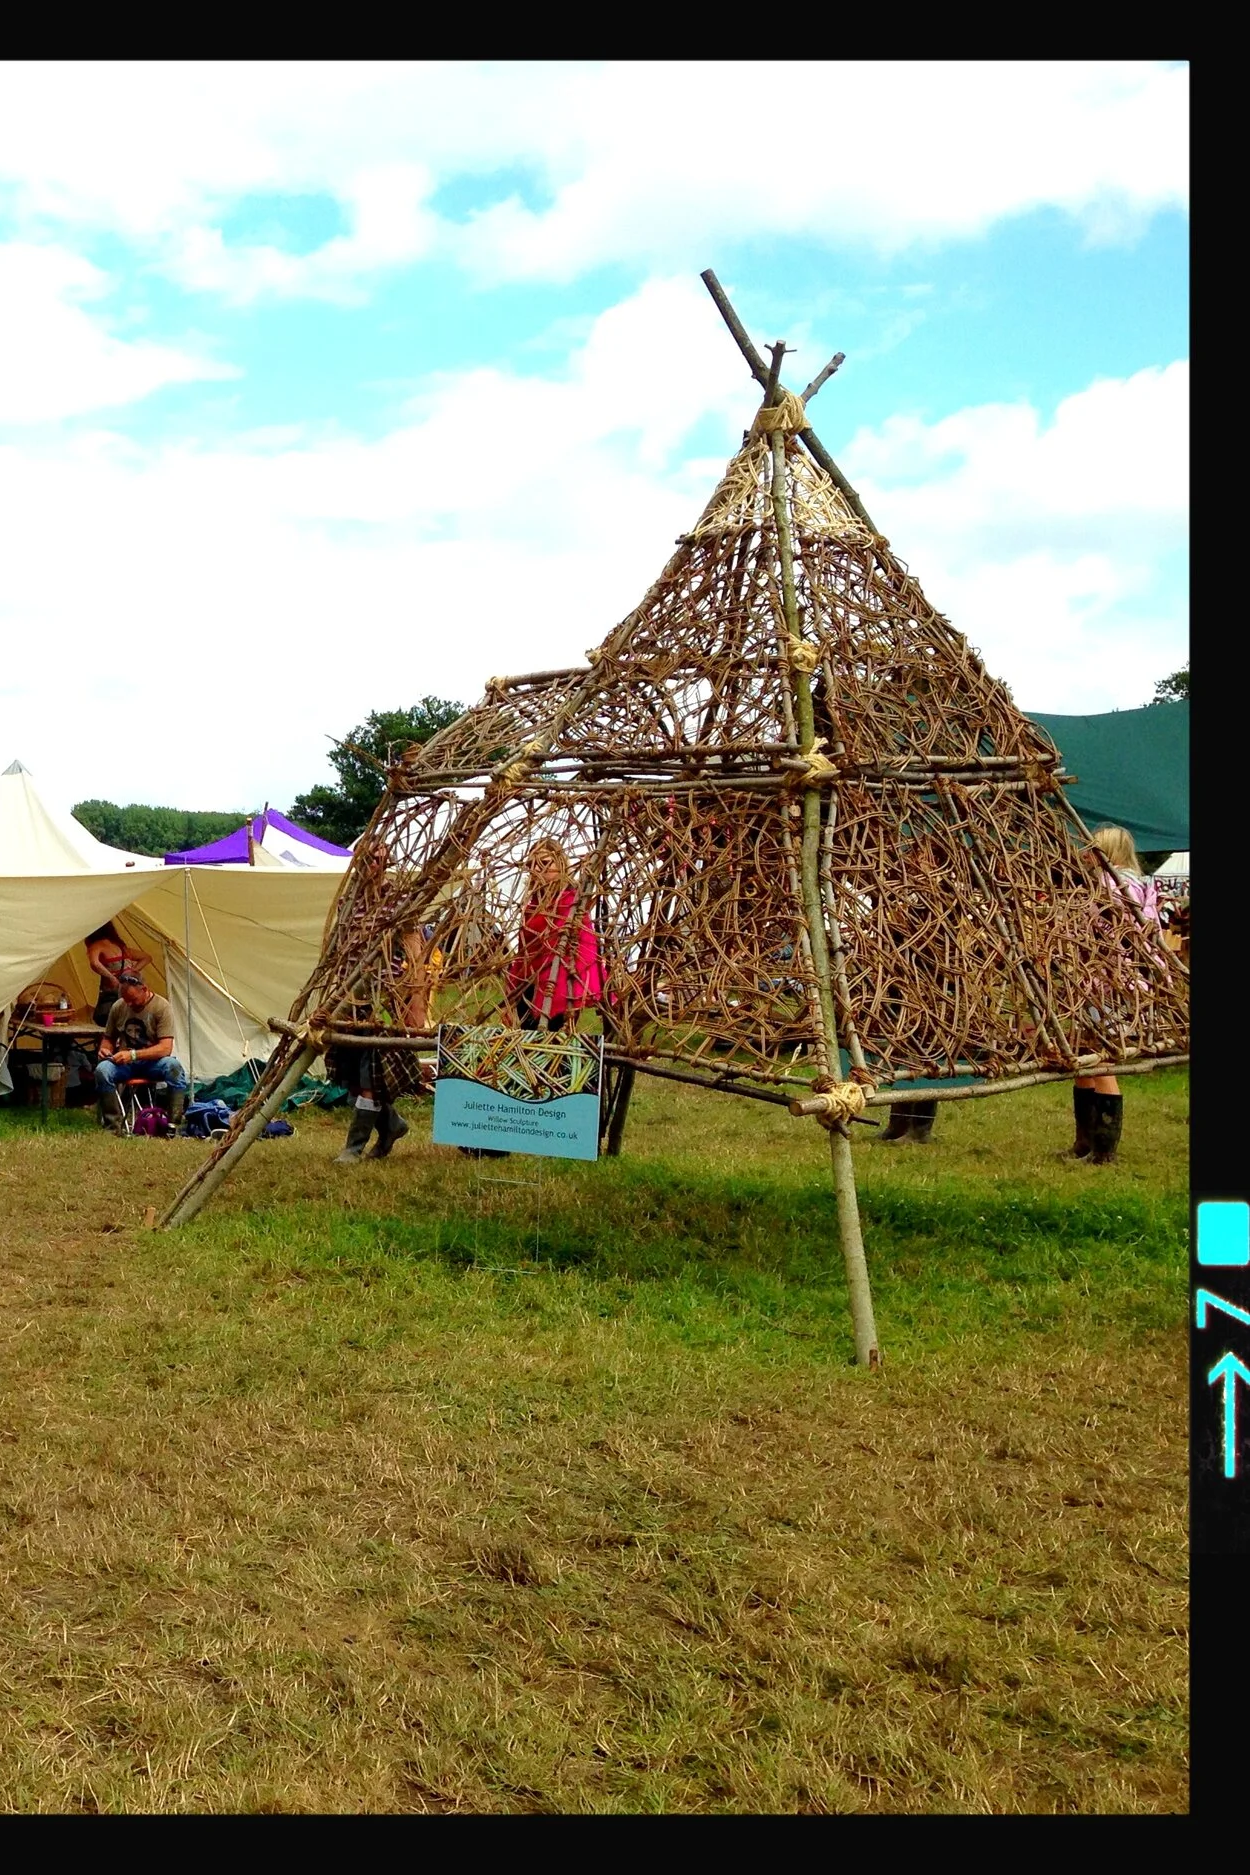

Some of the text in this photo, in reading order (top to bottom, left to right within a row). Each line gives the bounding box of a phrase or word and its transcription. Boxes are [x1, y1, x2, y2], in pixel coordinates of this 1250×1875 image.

[463, 1101, 566, 1120] Juliette Hamilton Design
[488, 1115, 540, 1127] Willow Sculpture
